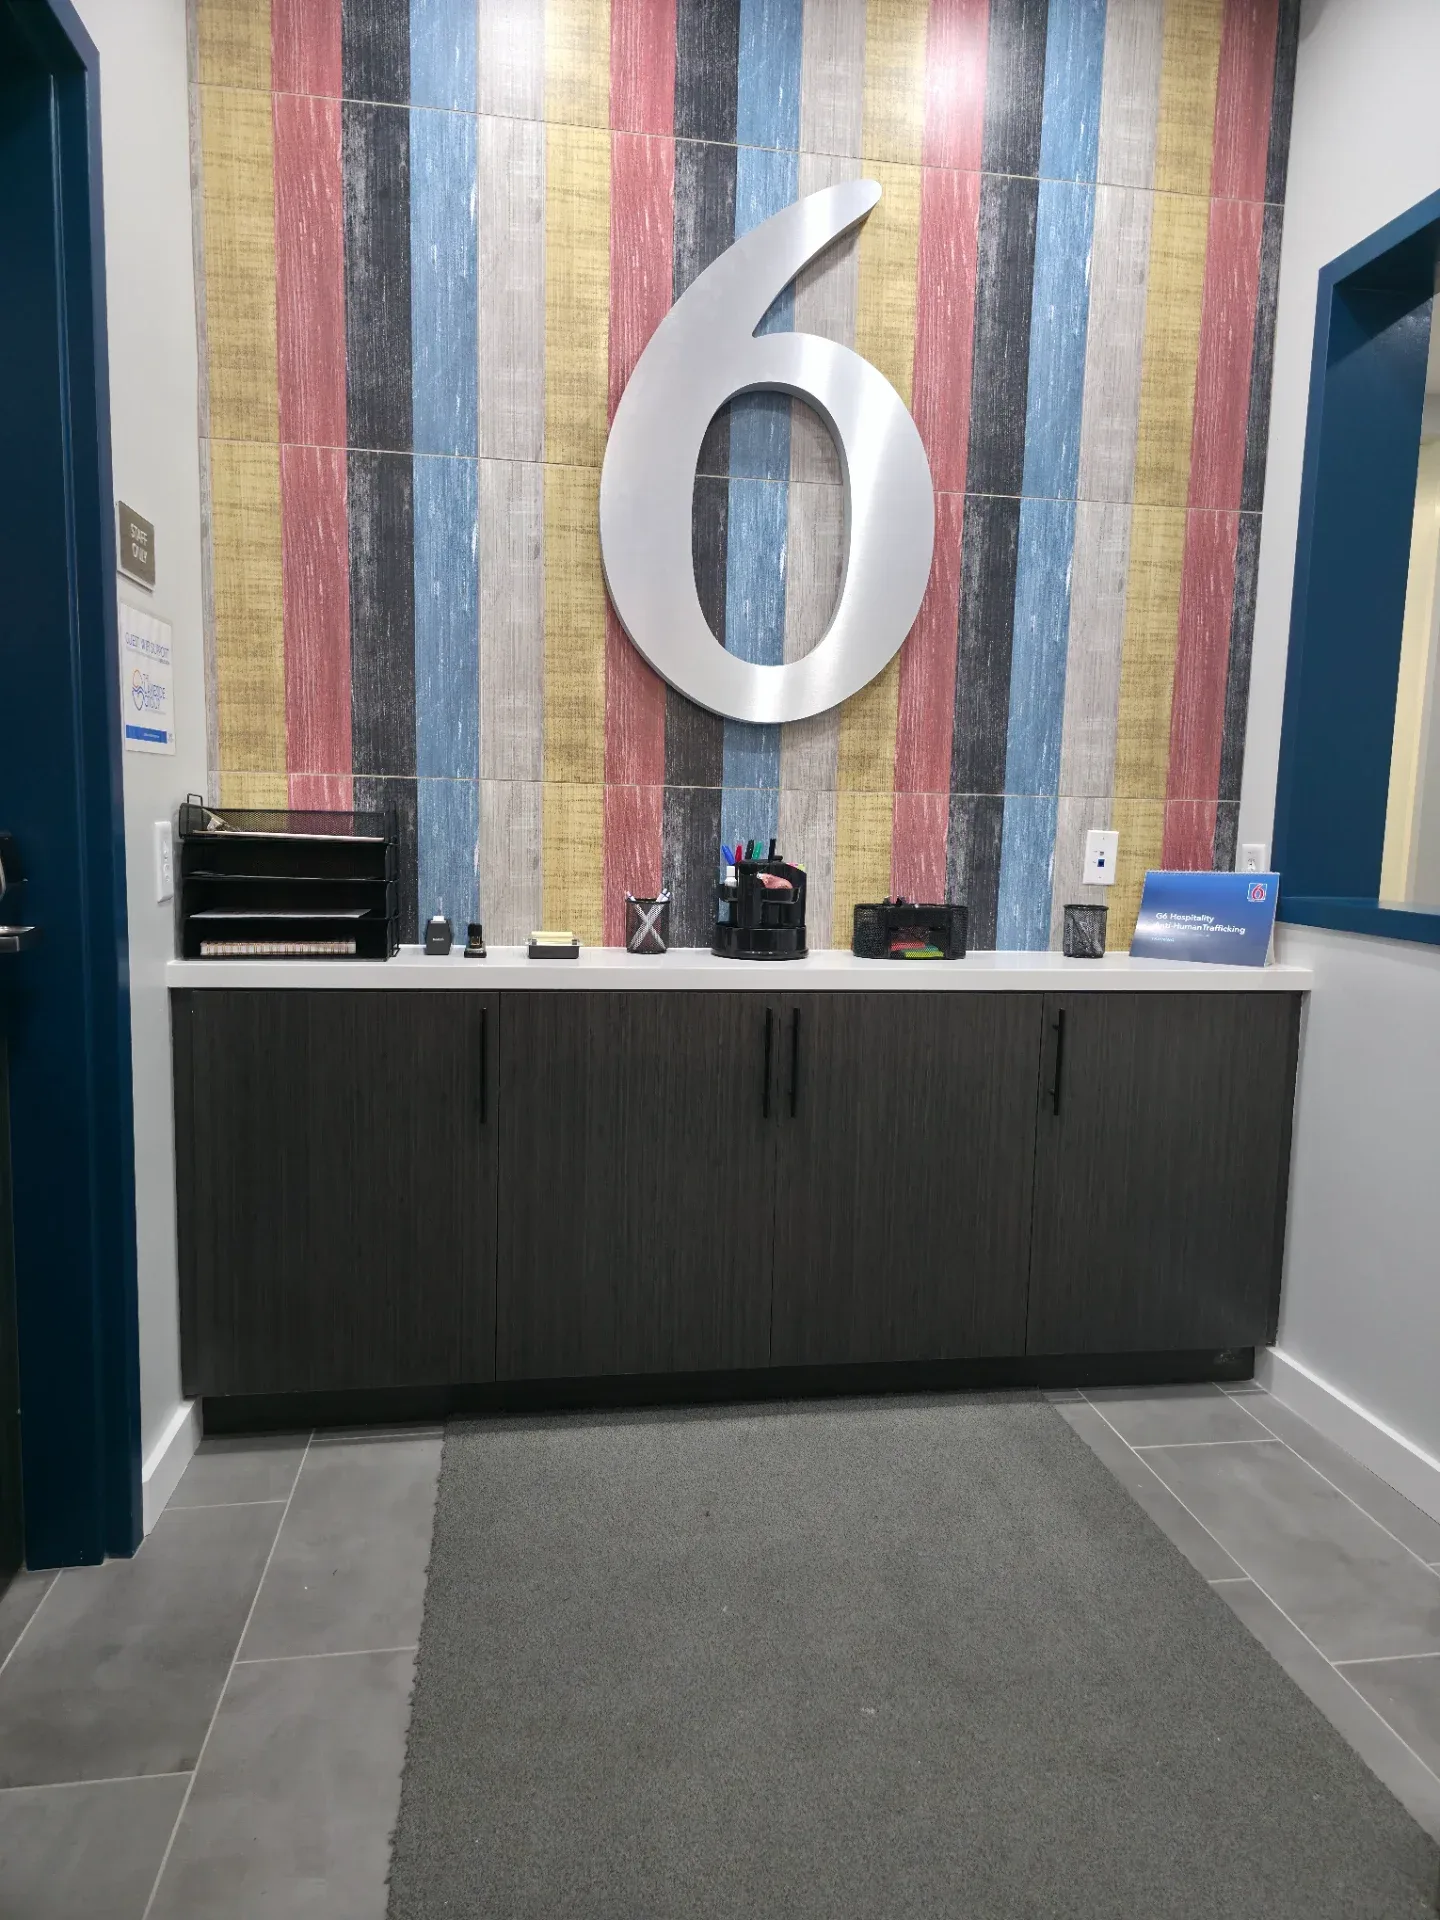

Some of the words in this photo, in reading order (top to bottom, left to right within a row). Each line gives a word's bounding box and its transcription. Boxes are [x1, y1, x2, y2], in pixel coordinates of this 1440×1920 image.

[599, 179, 934, 723] 6
[131, 523, 147, 546] STAFF
[132, 542, 147, 564] ONLY
[1251, 882, 1265, 900] 6
[1155, 912, 1168, 920] G6
[1170, 913, 1215, 924] Hospitality
[1202, 923, 1246, 935] Trafficking
